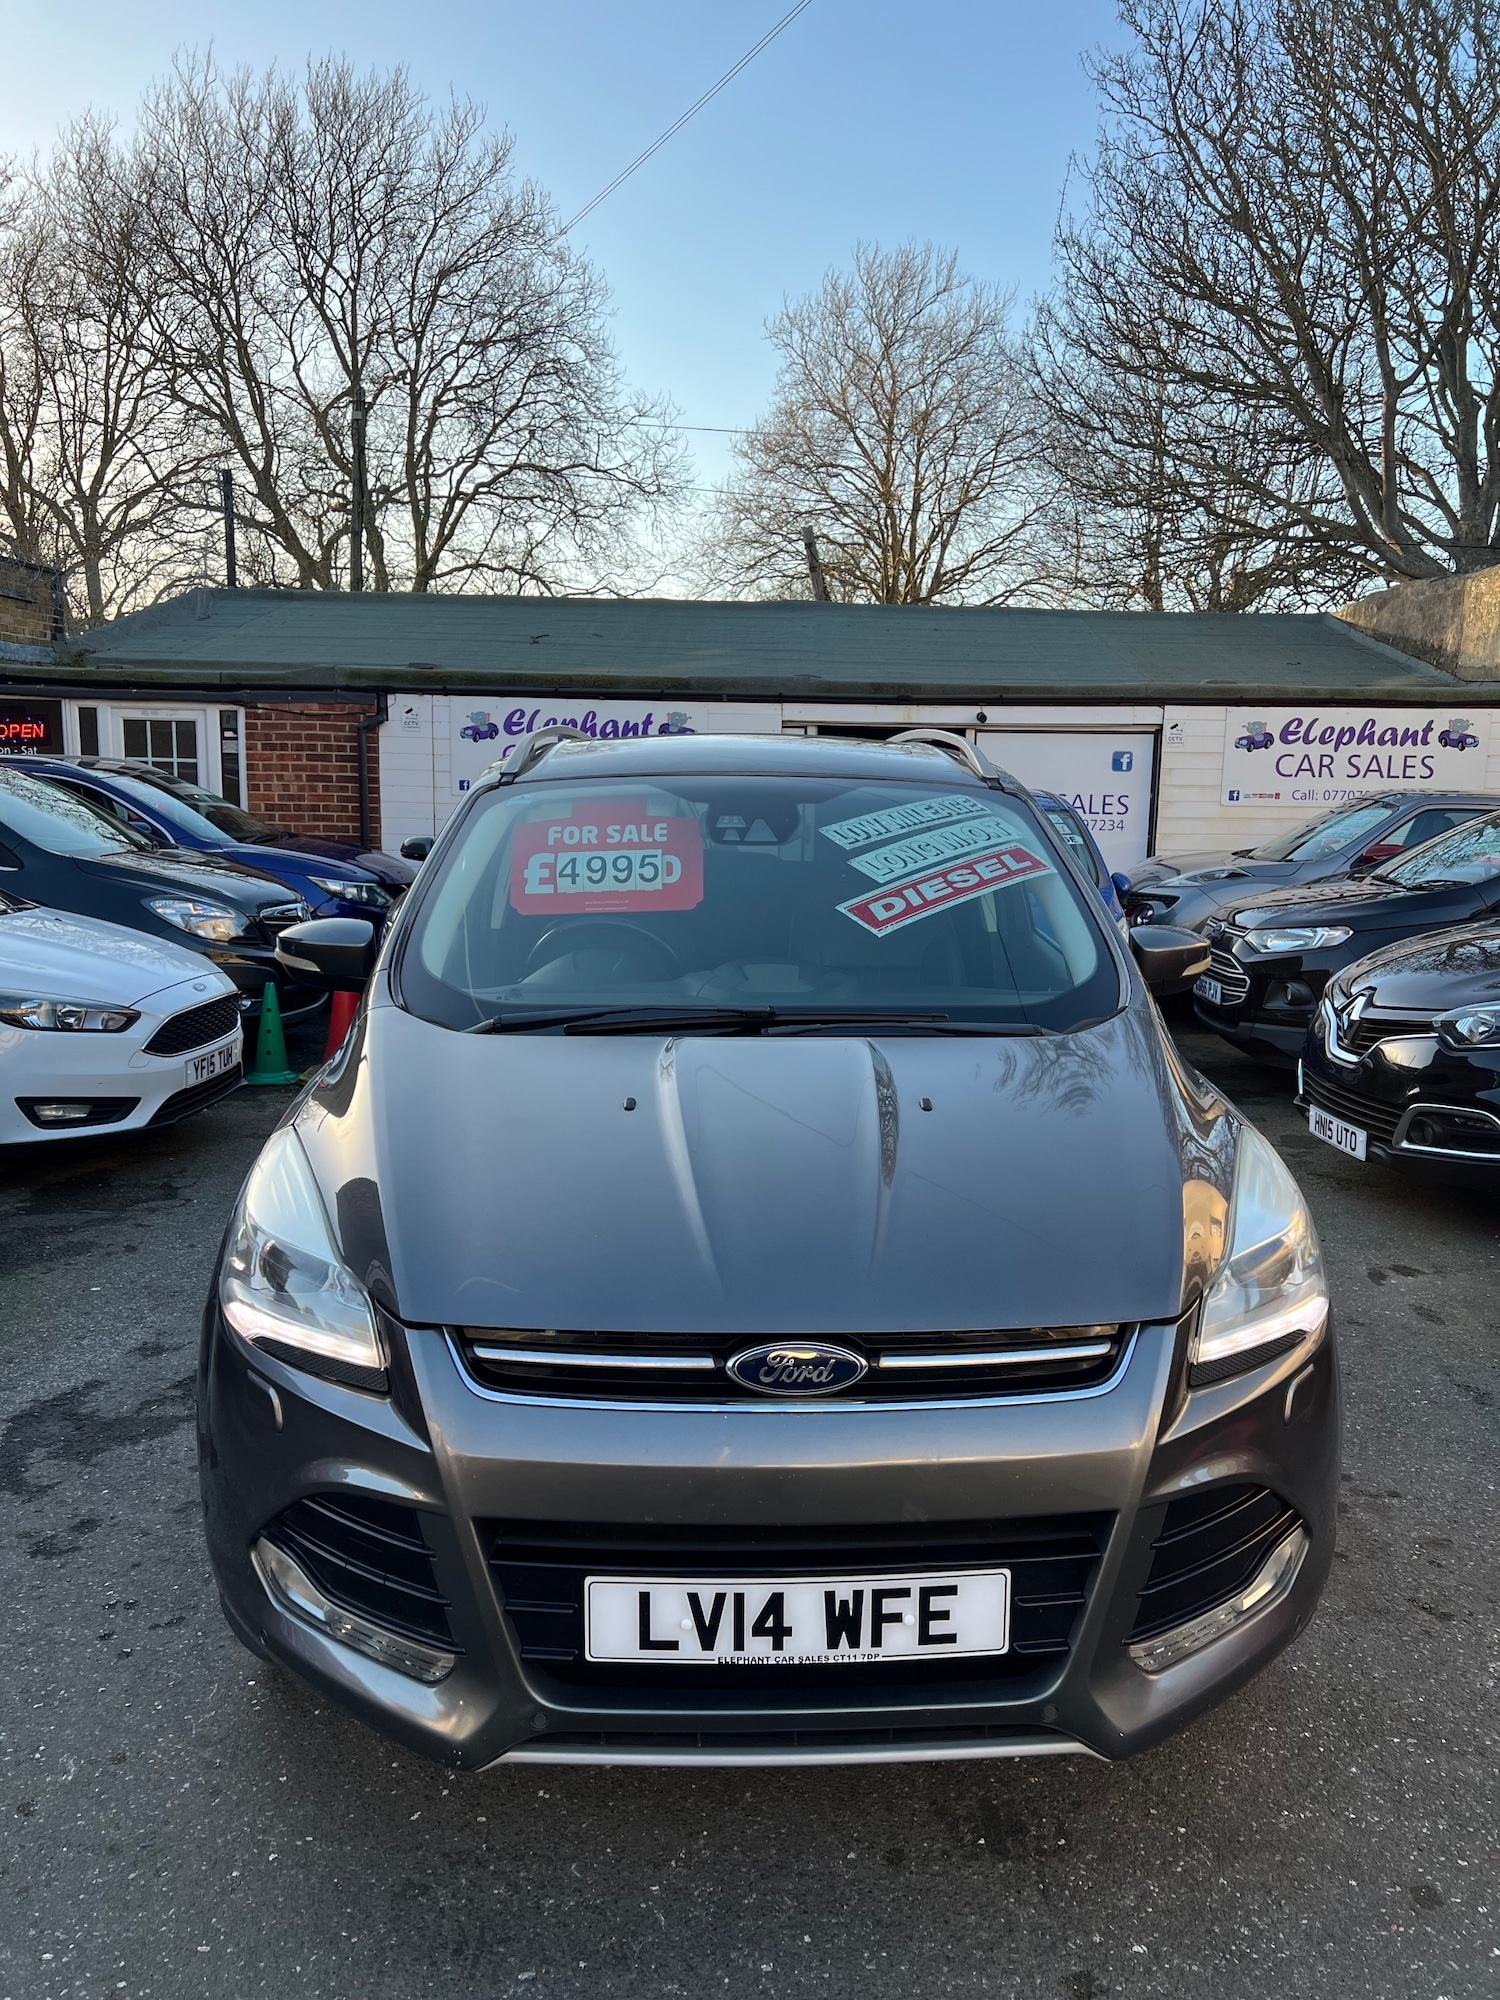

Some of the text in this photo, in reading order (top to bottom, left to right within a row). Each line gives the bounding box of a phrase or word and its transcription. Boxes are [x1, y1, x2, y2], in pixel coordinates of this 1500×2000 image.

[1279, 717, 1435, 752] Elephant
[21, 746, 38, 756] Sat
[1275, 754, 1435, 779] CAR SALES
[1058, 793, 1129, 815] ALES
[1291, 789, 1319, 801] Call:
[547, 822, 668, 845] FOR SALE
[828, 797, 988, 846] LOW MILEAGE
[858, 840, 945, 877] LONG
[866, 854, 1033, 922] DIESEL
[1336, 1123, 1357, 1152] UTO
[758, 1351, 836, 1383] Ford
[638, 1584, 959, 1651] LV14 WFE
[717, 1653, 880, 1665] ELEPHANT CAR SALES CT11 7DP
